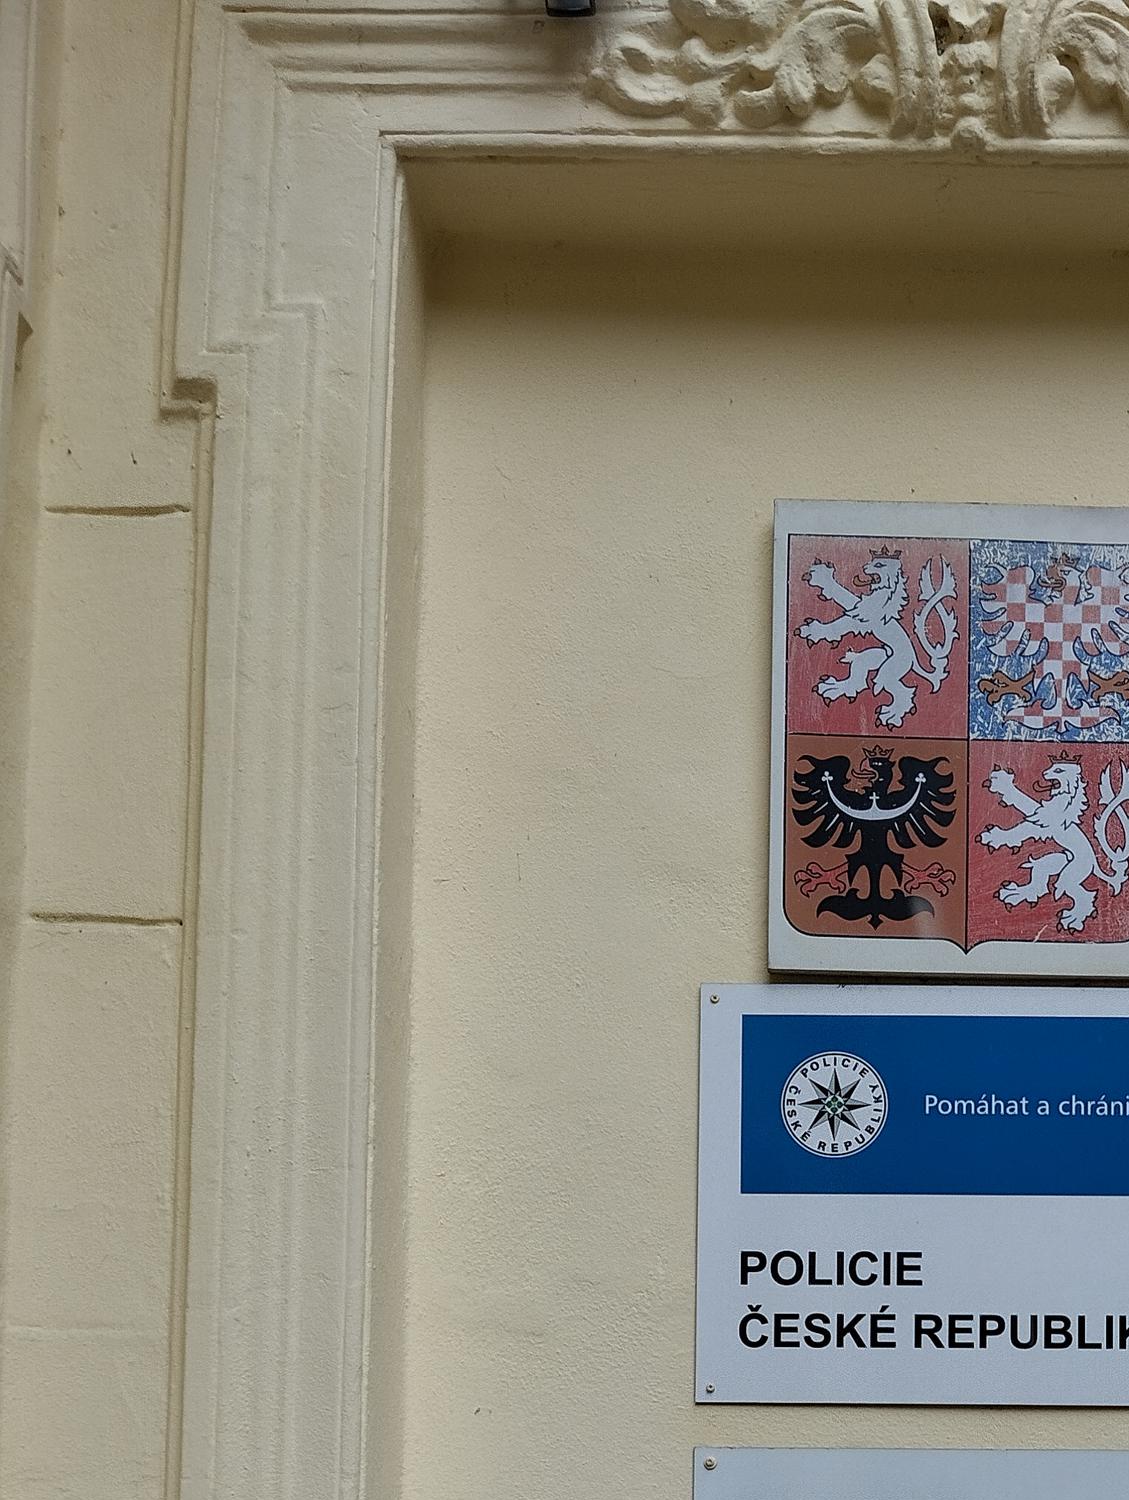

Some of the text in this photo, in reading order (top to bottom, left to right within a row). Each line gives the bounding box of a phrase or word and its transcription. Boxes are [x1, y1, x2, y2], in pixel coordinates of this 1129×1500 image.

[800, 1056, 870, 1078] POLICIE
[786, 1083, 883, 1153] ČESKÉ REPUBLIKY
[924, 1094, 1031, 1117] Pomáhat
[1036, 1100, 1051, 1117] a
[739, 1250, 924, 1288] POLICIE
[738, 1304, 897, 1349] ČESKÉ
